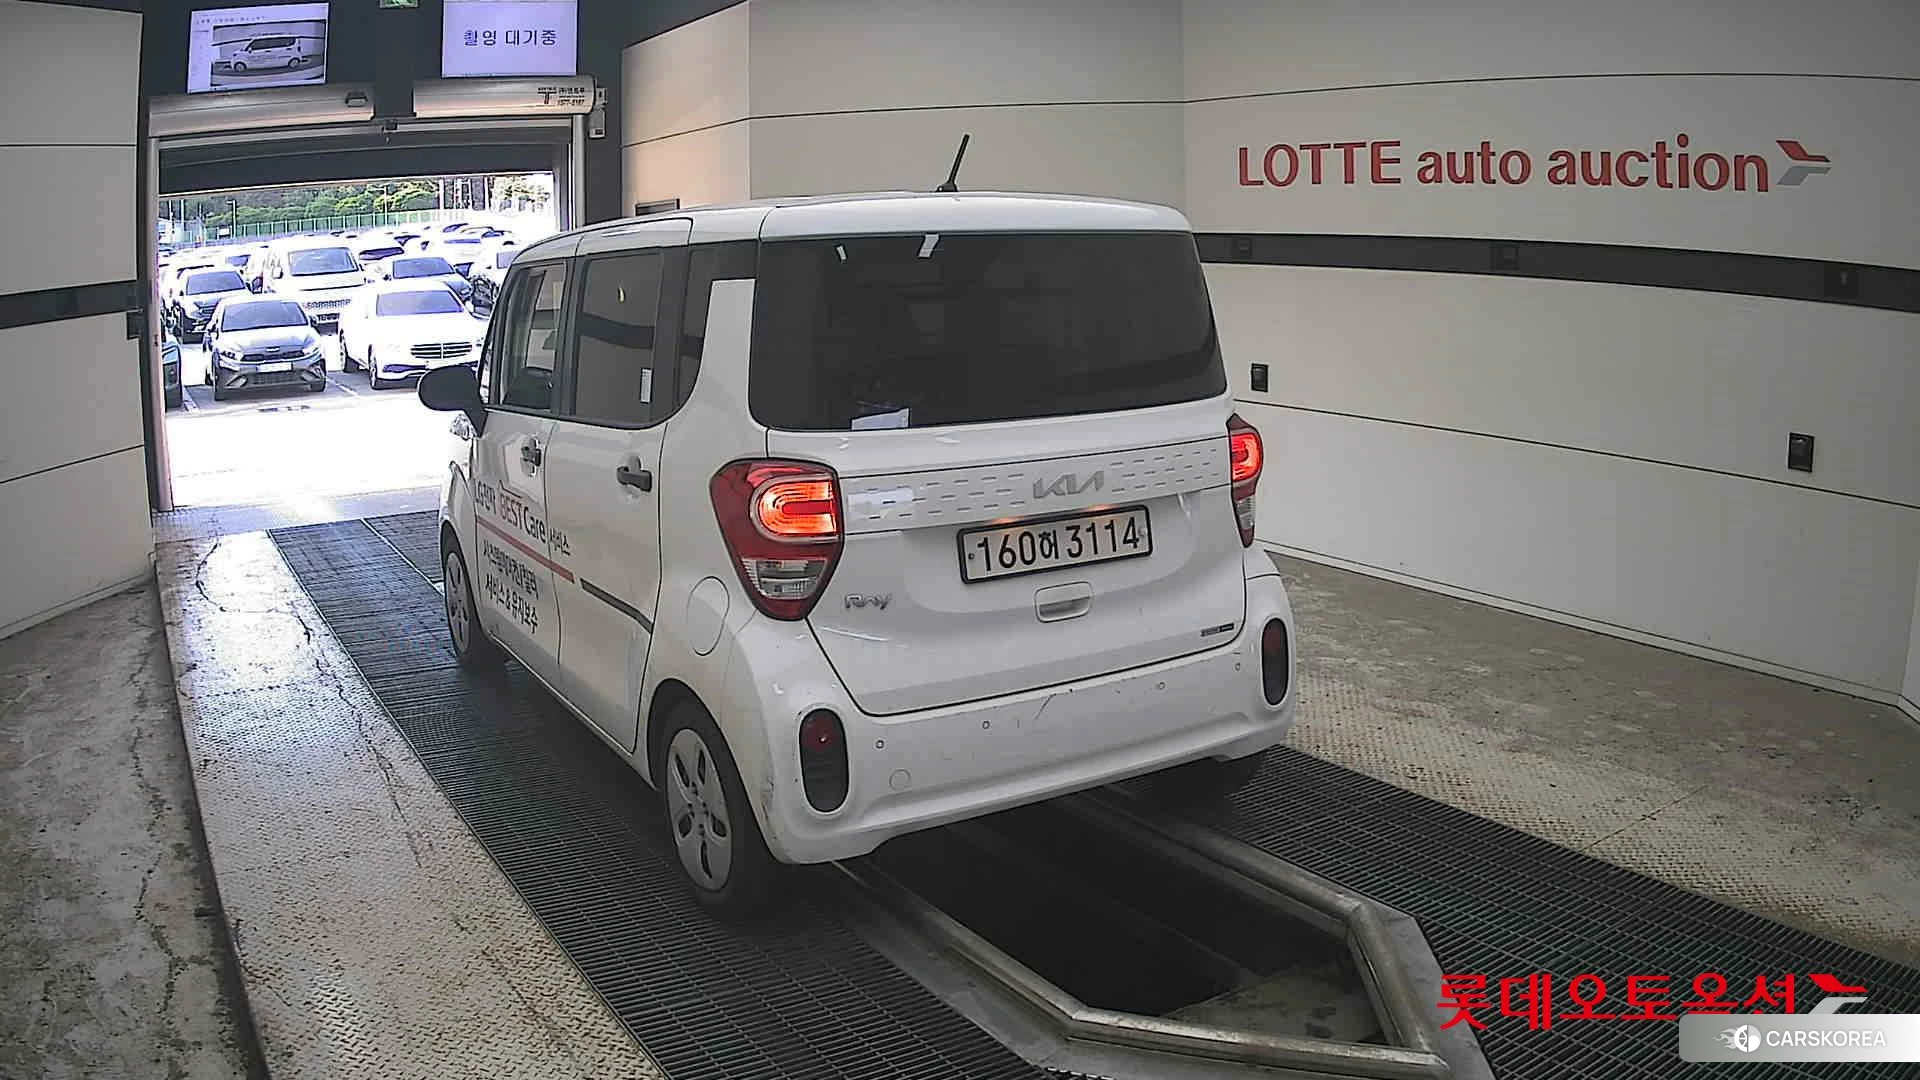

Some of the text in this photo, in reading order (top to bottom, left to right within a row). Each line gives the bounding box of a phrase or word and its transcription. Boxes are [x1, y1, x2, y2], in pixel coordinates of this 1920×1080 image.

[505, 29, 557, 47] 대기중
[1238, 133, 1770, 193] LOTTE auto auction
[1032, 470, 1105, 500] KIA
[500, 492, 523, 531] BEST
[523, 506, 547, 544] Care
[976, 516, 1140, 572] 160허 3114
